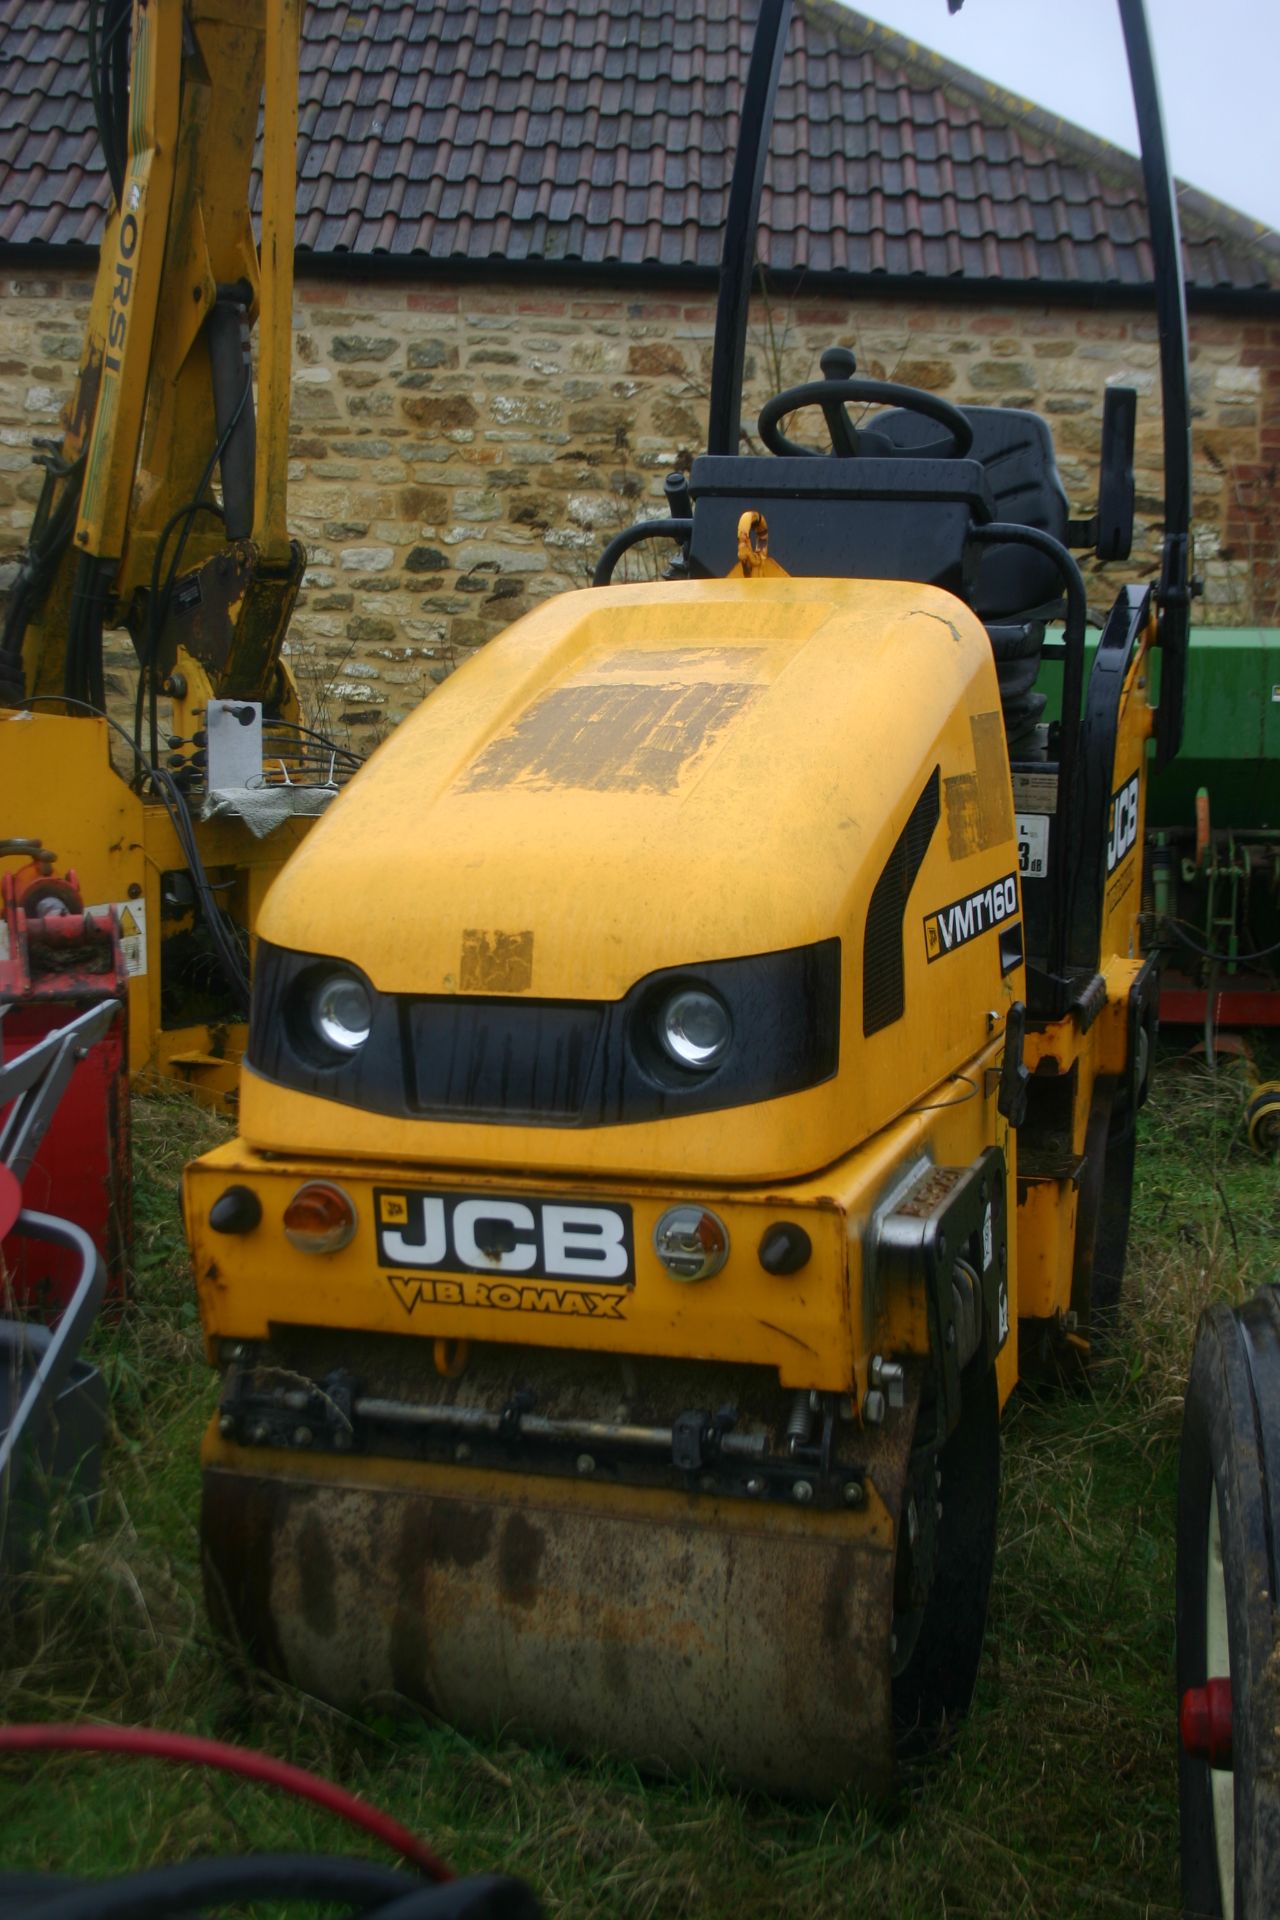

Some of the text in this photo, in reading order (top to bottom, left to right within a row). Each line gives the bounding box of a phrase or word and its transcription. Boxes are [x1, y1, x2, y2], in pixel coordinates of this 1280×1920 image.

[105, 214, 137, 372] ORSI
[1107, 777, 1138, 871] JCB
[938, 877, 1016, 948] VMT160
[382, 1197, 628, 1278] JCB
[387, 1275, 628, 1320] VIBROMAX
